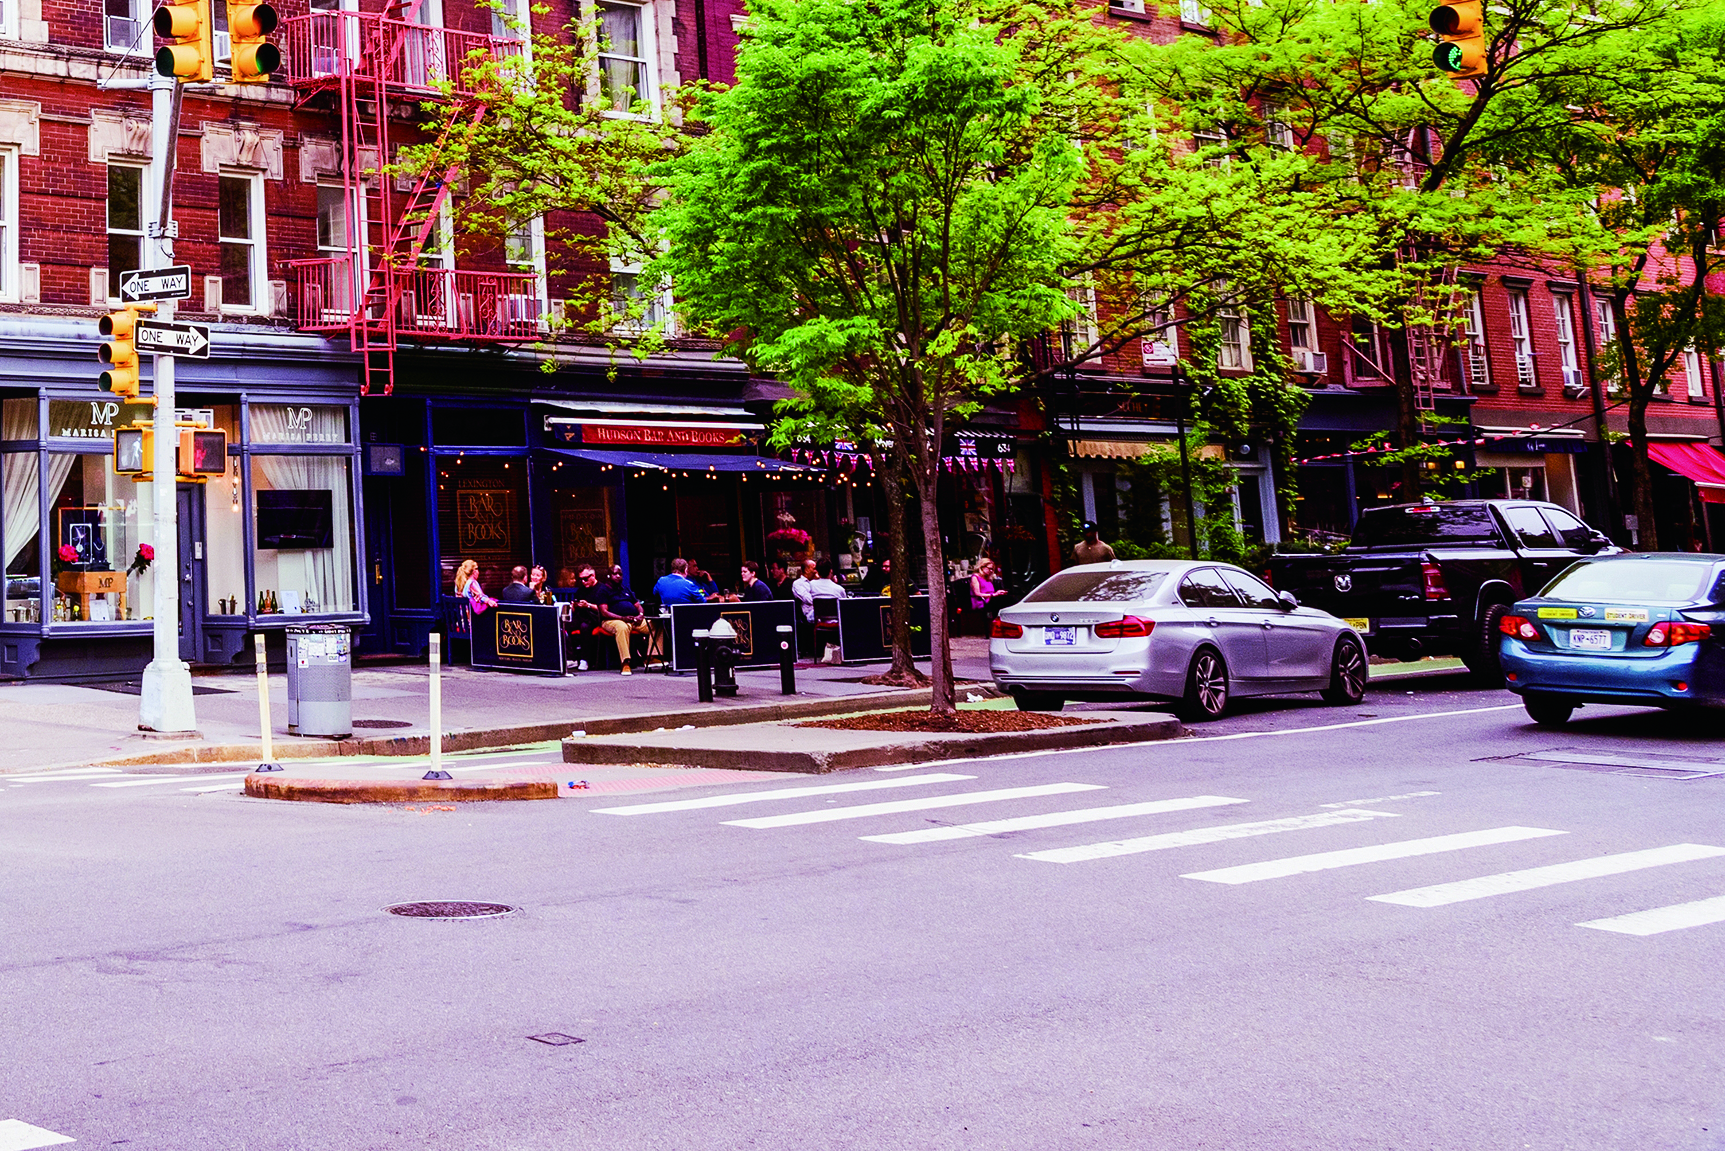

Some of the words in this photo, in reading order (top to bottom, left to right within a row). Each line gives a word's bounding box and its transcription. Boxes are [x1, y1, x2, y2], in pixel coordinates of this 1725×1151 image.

[130, 280, 150, 293] ONE
[161, 276, 184, 290] WAY
[141, 329, 163, 343] ONE
[175, 333, 199, 346] WAY
[90, 401, 119, 426] MP
[286, 406, 313, 431] MP
[62, 428, 107, 438] MARISA
[305, 432, 339, 444] PERRY
[597, 427, 641, 441] HUDSON
[644, 429, 664, 442] BAR
[667, 430, 690, 442] AND
[691, 430, 725, 443] BOOKS
[997, 443, 1011, 454] 634
[458, 479, 505, 488] LEXINGTON
[465, 495, 503, 519] BAR
[463, 521, 507, 547] BOOKS
[1606, 612, 1628, 620] STUDENT
[501, 618, 528, 633] BAR
[499, 634, 530, 651] BOOKS
